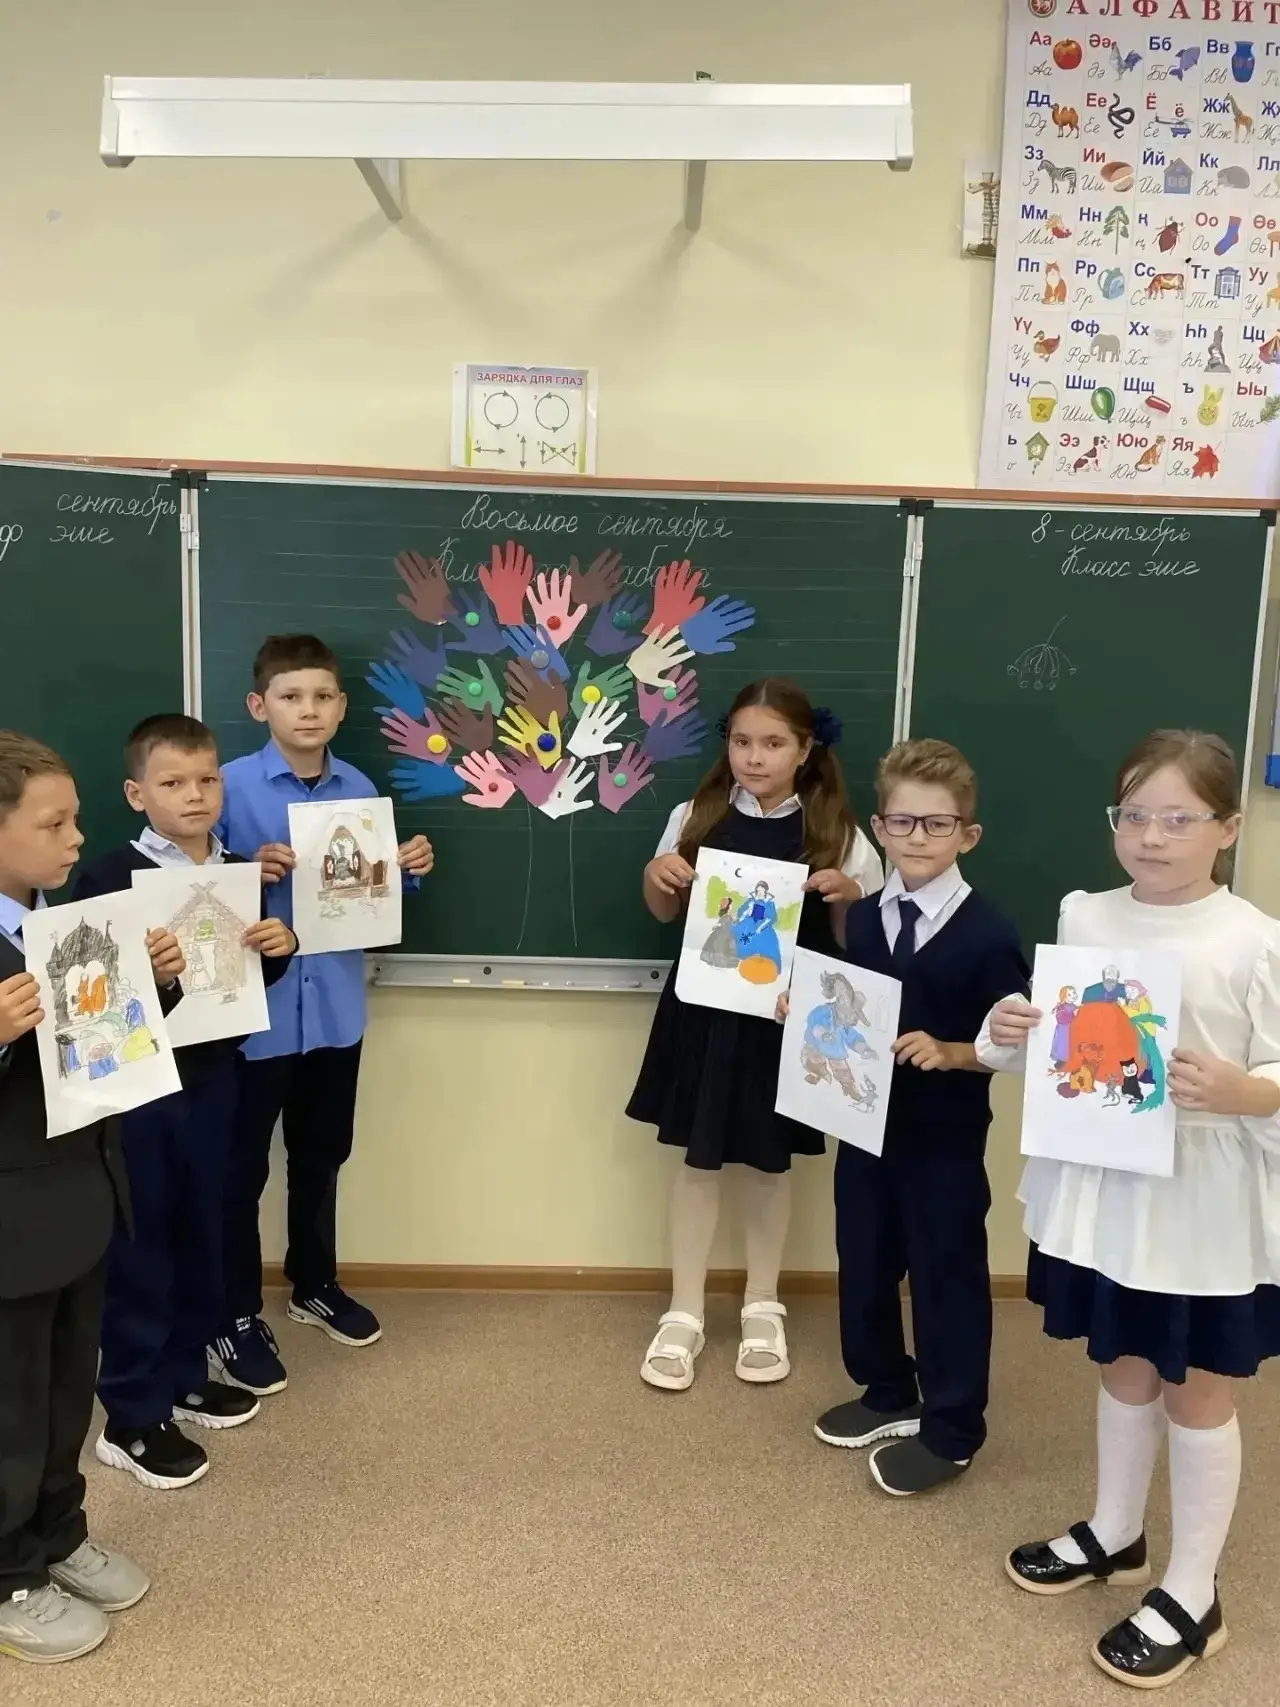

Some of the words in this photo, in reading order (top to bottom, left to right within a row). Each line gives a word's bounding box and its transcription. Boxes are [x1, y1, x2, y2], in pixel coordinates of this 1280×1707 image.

[1030, 32, 1052, 46] Аа
[1089, 34, 1111, 48] Әә
[1149, 37, 1172, 51] Бб
[1207, 40, 1229, 53] Вв
[1028, 60, 1052, 76] Аа
[1026, 91, 1050, 107] Дд
[1086, 94, 1106, 107] Ее
[1146, 93, 1156, 110] Ё
[1203, 98, 1230, 113] Жж
[1084, 118, 1100, 133] Ее
[1024, 146, 1044, 160] Зз
[1084, 149, 1106, 162] Ии
[1143, 151, 1165, 166] Йй
[1200, 154, 1218, 168] Кк
[1022, 206, 1048, 220] Мм
[1080, 208, 1102, 222] Нн
[1196, 212, 1218, 226] Оо
[1254, 215, 1276, 230] Өө
[1018, 258, 1040, 273] Пп
[1075, 260, 1097, 277] Рр
[1134, 262, 1155, 277] Сс
[1192, 265, 1210, 279] Тт
[1249, 267, 1268, 285] Уу
[1070, 320, 1100, 337] Фф
[1128, 322, 1149, 336] Хх
[1243, 326, 1265, 342] Цц
[477, 372, 527, 384] ЗАРЯДКА
[529, 375, 552, 385] ДЛЯ
[555, 376, 583, 386] ГЛАЗ
[1010, 373, 1030, 387] Чч
[1066, 375, 1096, 390] Шш
[1124, 378, 1154, 394] Щщ
[1237, 382, 1267, 396] Ыы
[1060, 434, 1080, 447] Ээ
[1117, 434, 1148, 448] Юю
[1172, 438, 1194, 452] Яя
[57, 484, 178, 535] сентябрь
[461, 494, 579, 533] Восьмое
[597, 506, 733, 553] сентября
[49, 526, 114, 544] эше
[1061, 545, 1132, 577] Класс
[1138, 560, 1200, 577] эше
